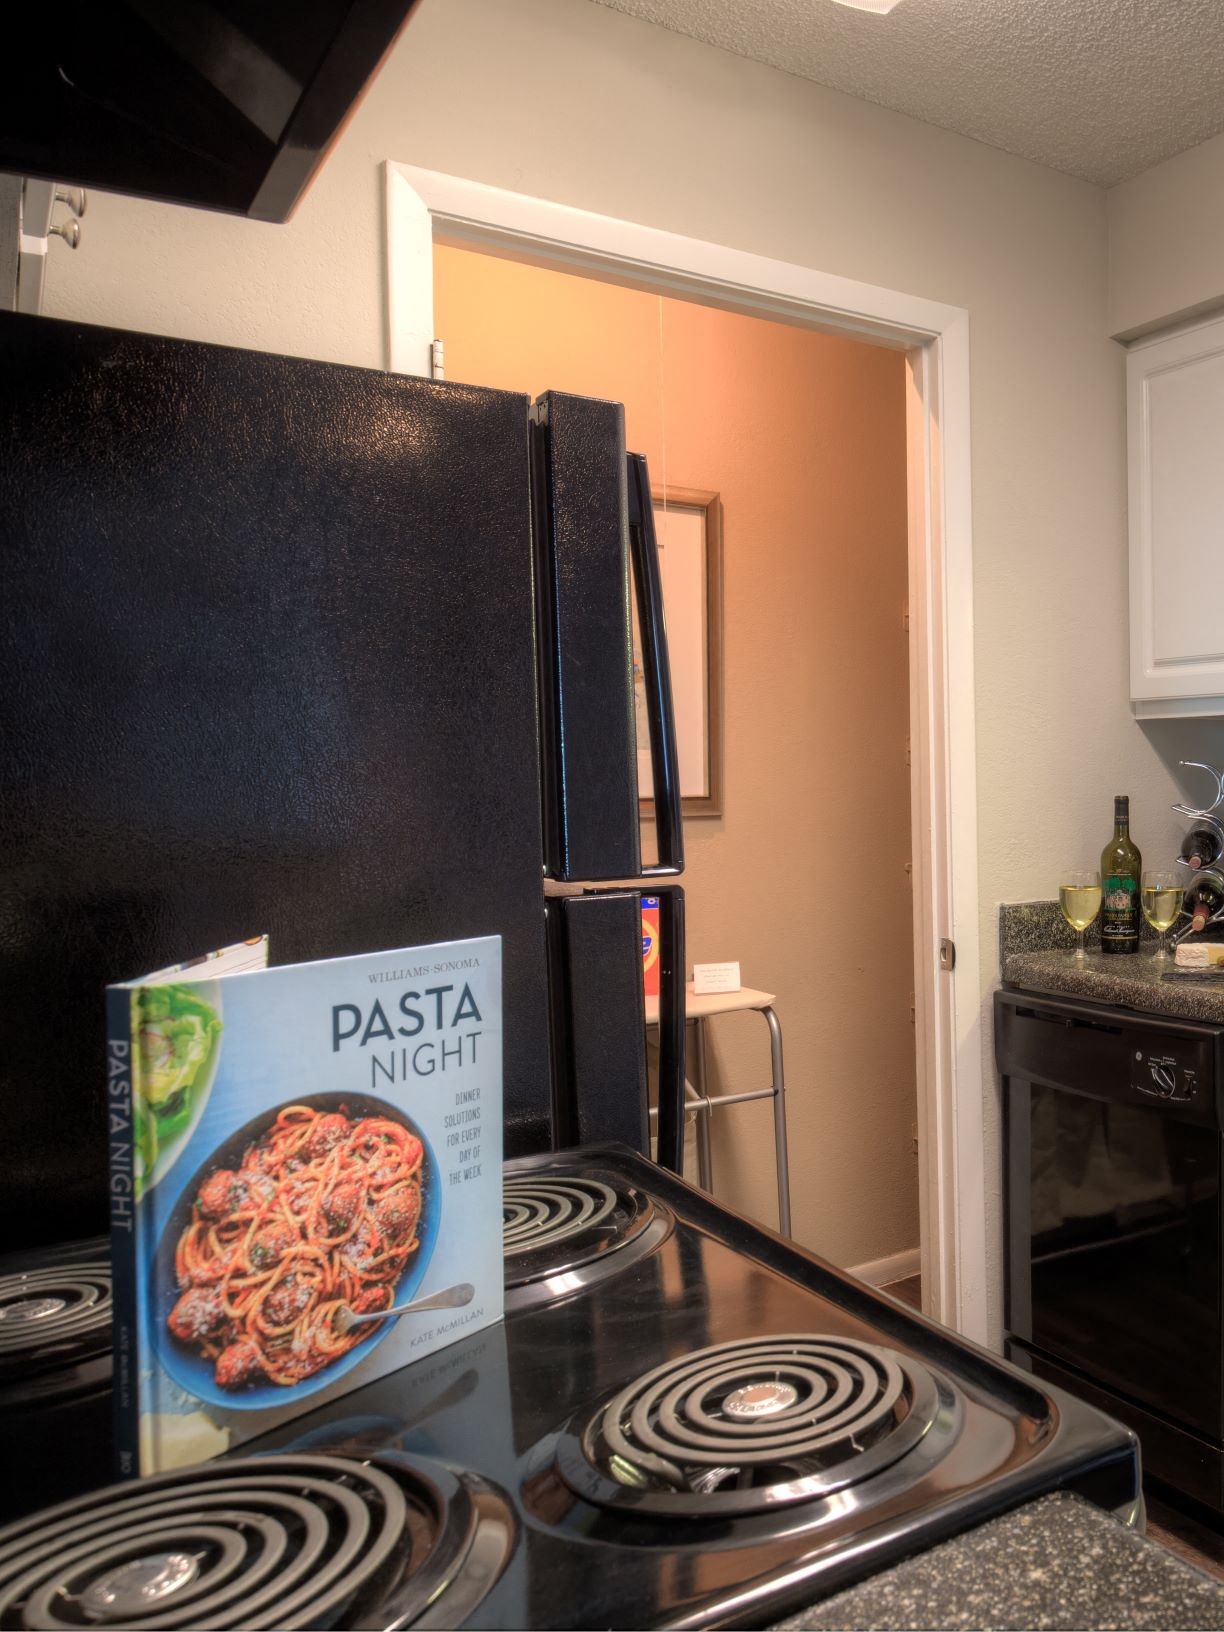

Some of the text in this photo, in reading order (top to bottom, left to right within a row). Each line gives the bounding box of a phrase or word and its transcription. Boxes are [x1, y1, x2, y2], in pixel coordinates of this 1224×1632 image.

[332, 981, 483, 1053] PASTA
[371, 1031, 482, 1089] NIGHT
[455, 1088, 481, 1106] DINNER
[444, 1107, 481, 1129] SOLUTIONS
[108, 1039, 132, 1232] PASTA NIGHT
[447, 1126, 482, 1148] FOR EVERY
[459, 1145, 481, 1164] DAY OF
[449, 1164, 482, 1186] THE WEEK
[410, 1307, 485, 1349] KATE McMILLAN
